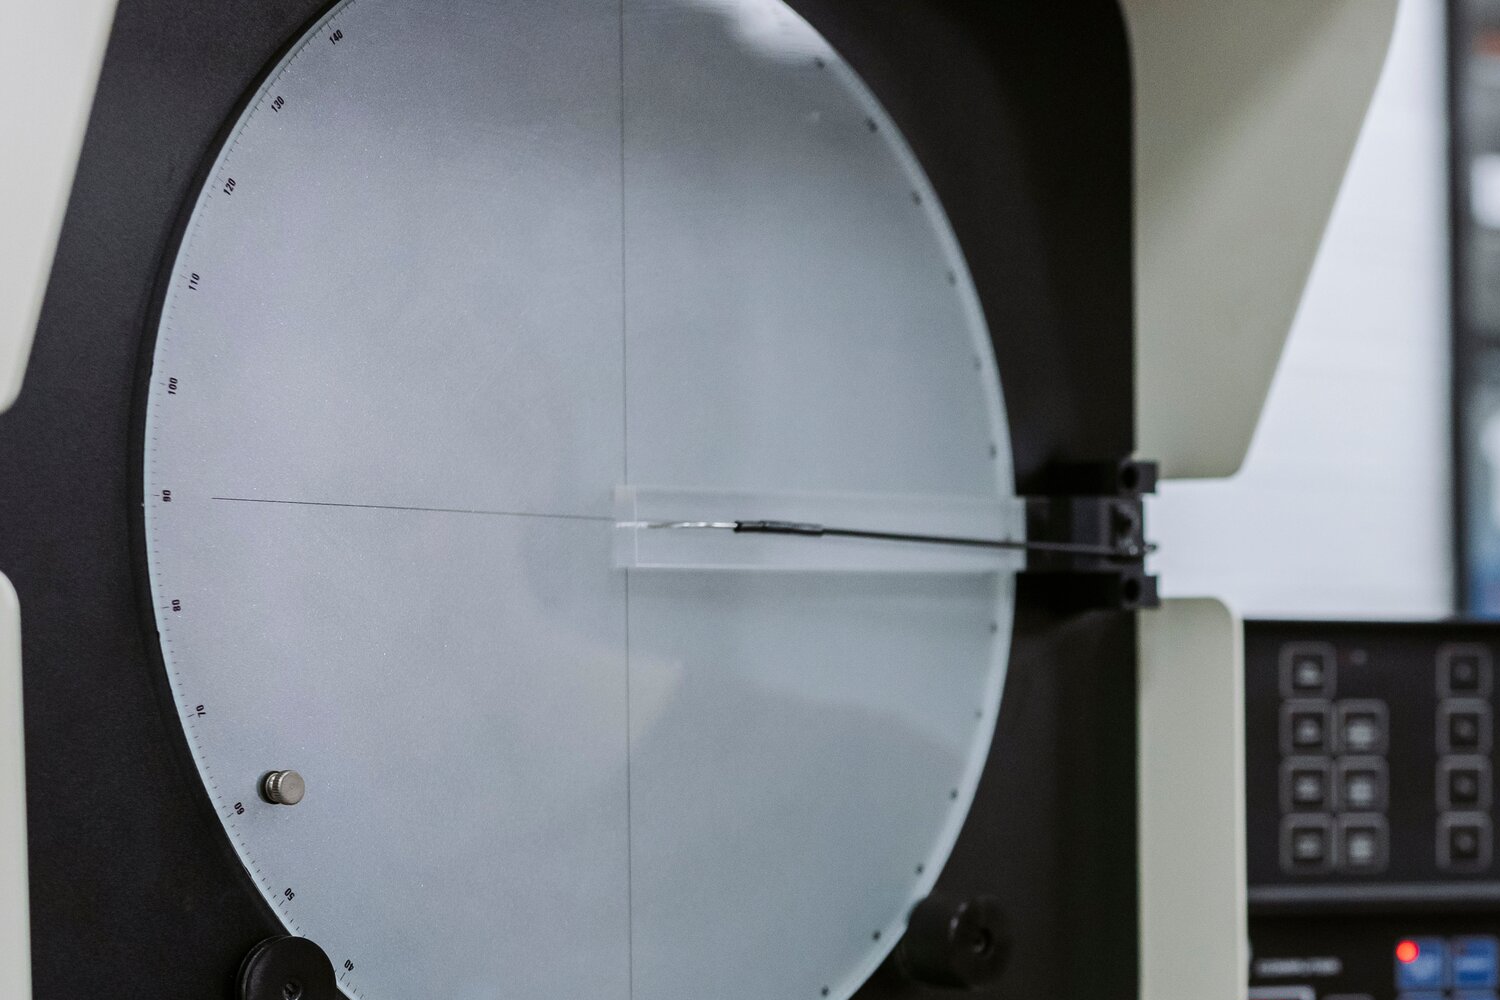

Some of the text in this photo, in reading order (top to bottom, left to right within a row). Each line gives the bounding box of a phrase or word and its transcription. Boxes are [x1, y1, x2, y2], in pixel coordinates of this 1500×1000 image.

[328, 29, 344, 46] 140
[270, 95, 285, 113] 130
[222, 177, 237, 196] 120
[187, 272, 201, 291] 110
[167, 376, 179, 395] 100
[162, 489, 172, 502] 90
[171, 598, 182, 612] 80
[195, 704, 207, 717] 70
[232, 801, 245, 816] 60
[283, 887, 296, 902] 50
[343, 959, 355, 973] 40
